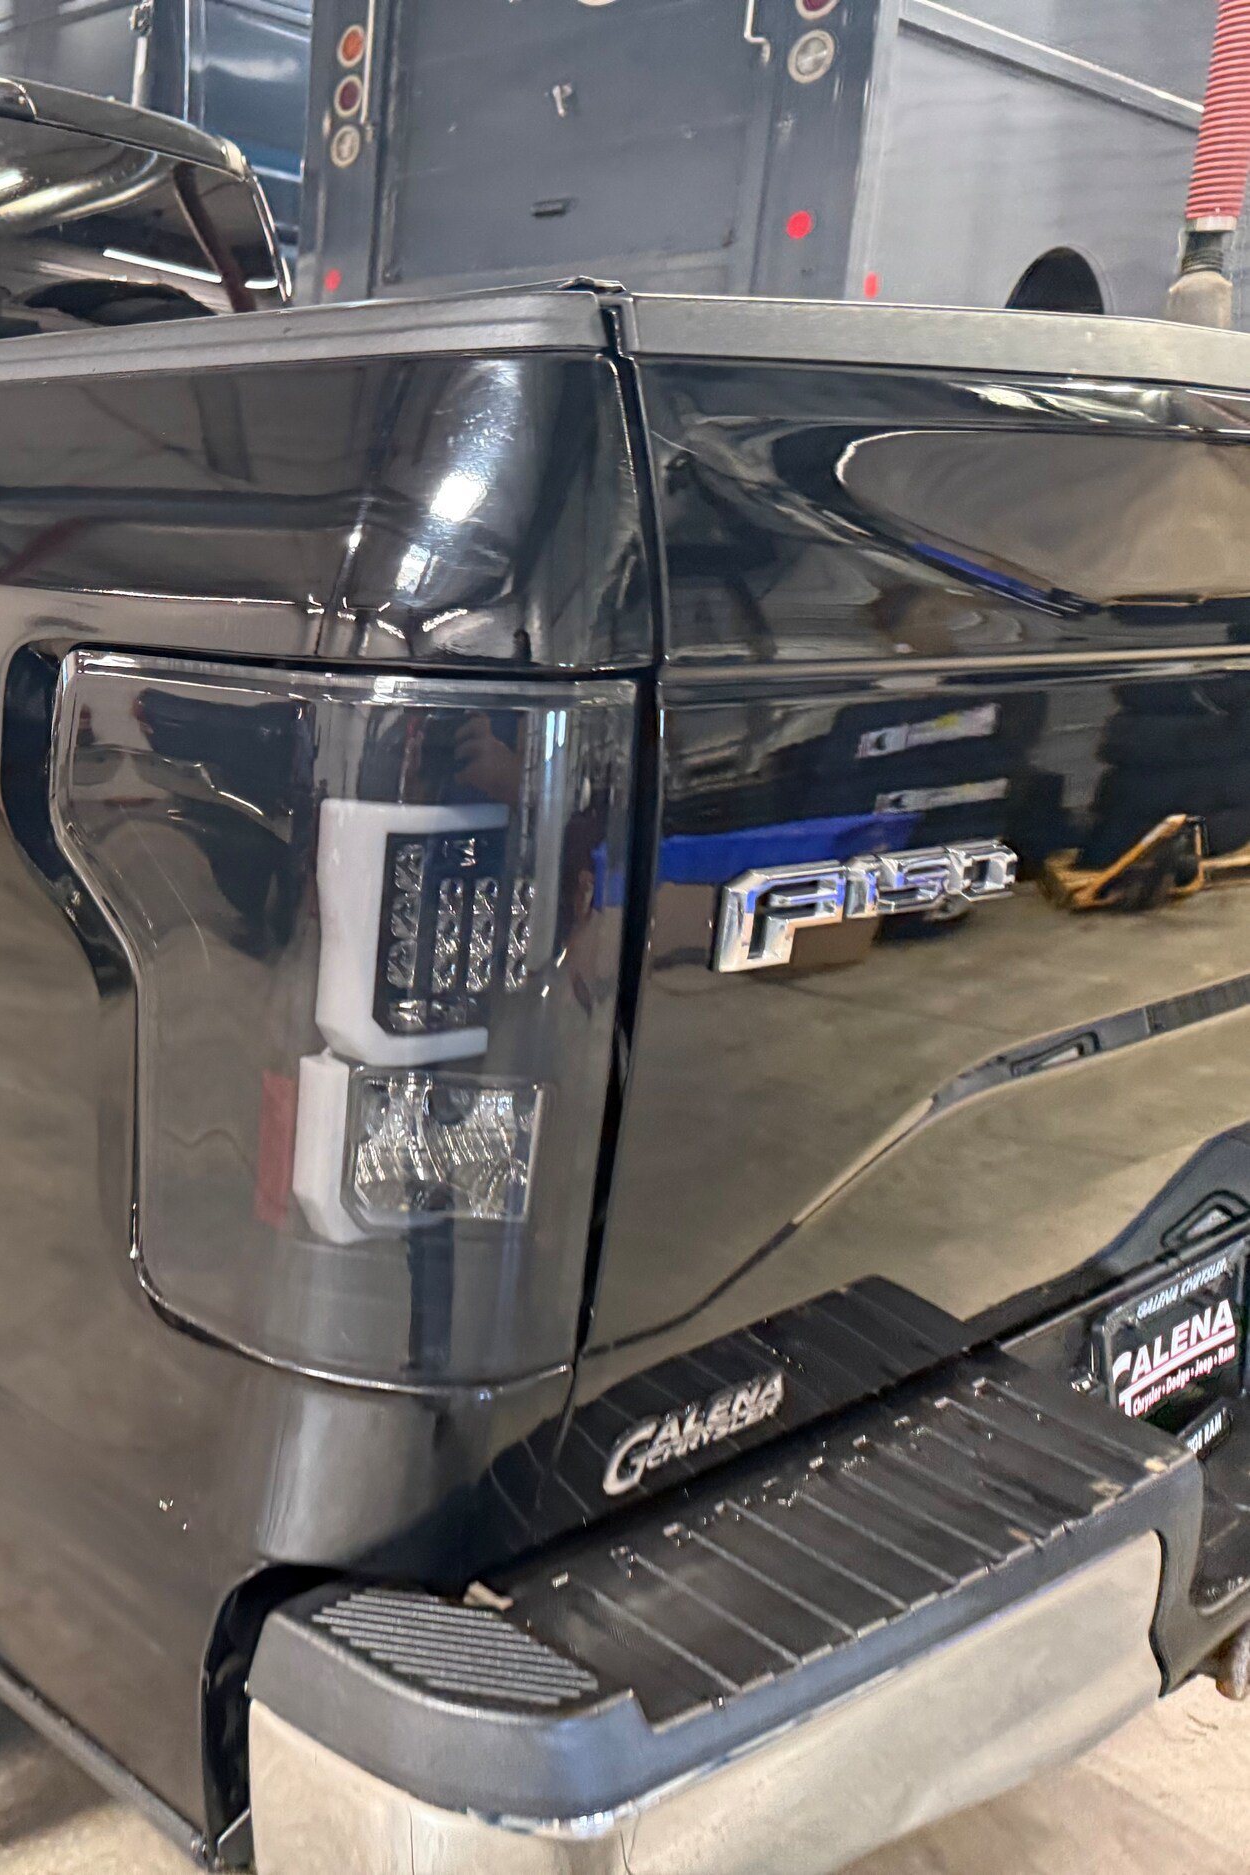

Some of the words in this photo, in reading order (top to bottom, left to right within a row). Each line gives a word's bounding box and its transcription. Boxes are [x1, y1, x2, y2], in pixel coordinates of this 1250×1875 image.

[1133, 1386, 1162, 1416] Chrysler
[1166, 1367, 1191, 1395] Dodge
[1194, 1354, 1214, 1379] Jeep
[1218, 1343, 1236, 1366] Ram
[602, 1372, 785, 1496] GALENA
[1204, 1411, 1222, 1445] RAM
